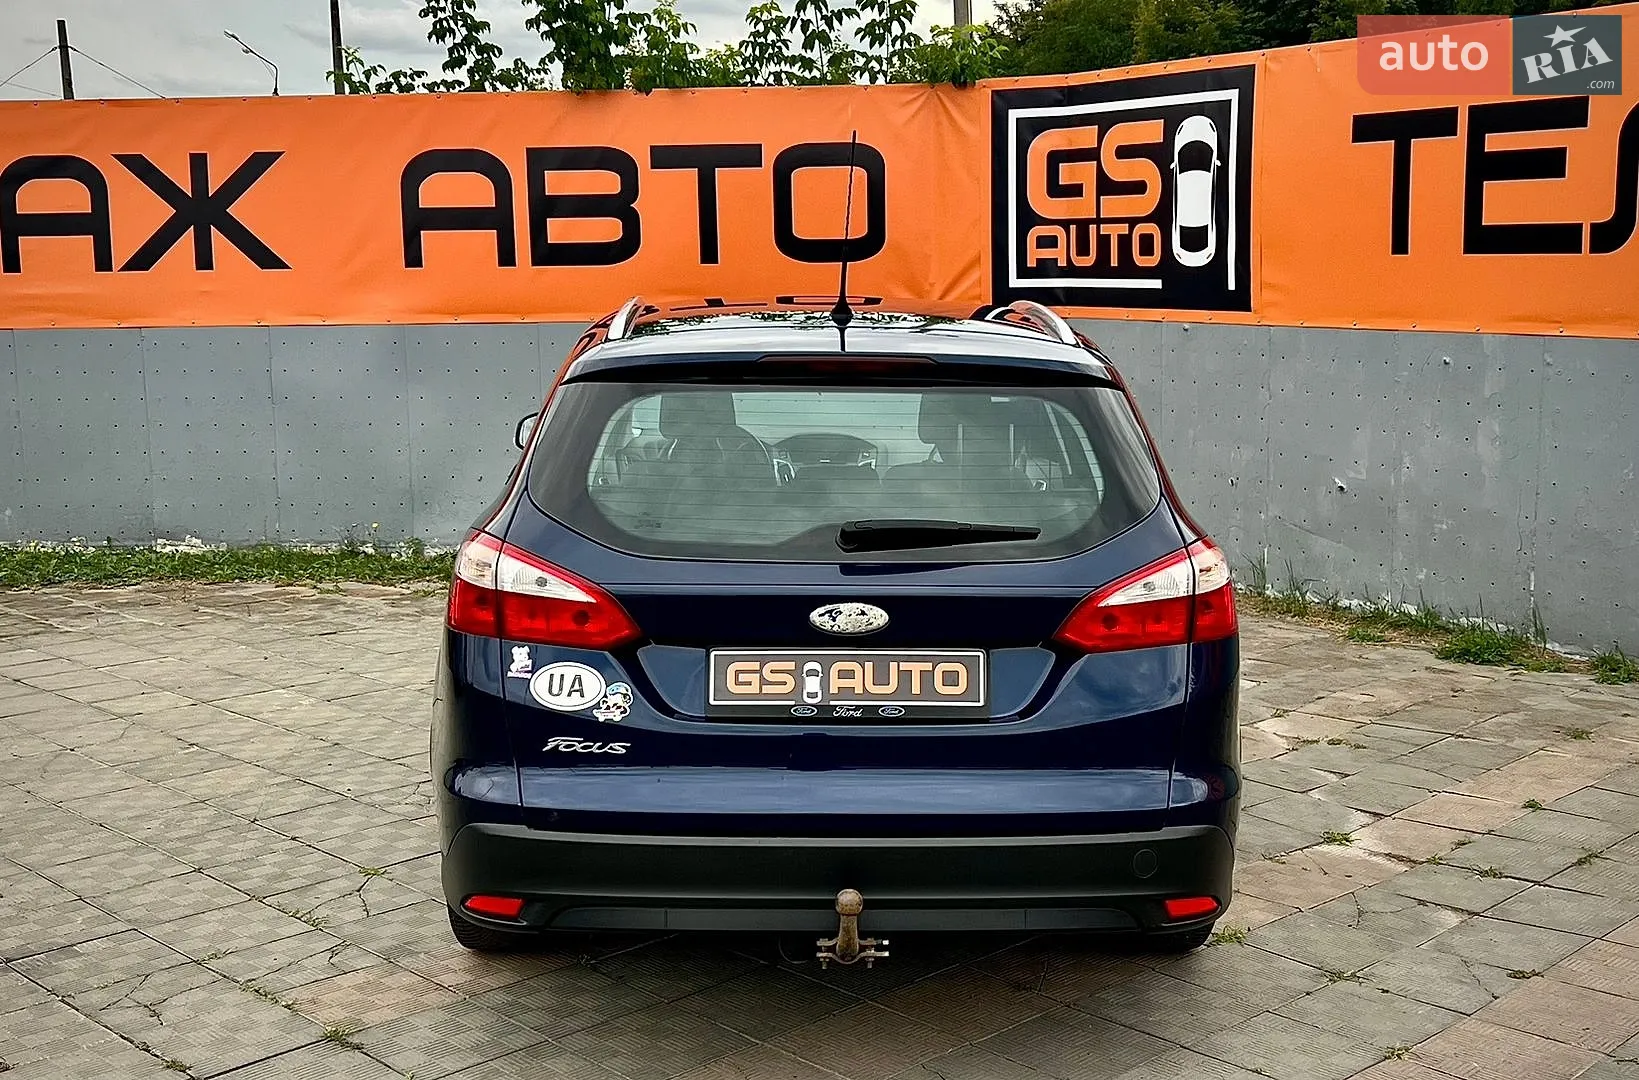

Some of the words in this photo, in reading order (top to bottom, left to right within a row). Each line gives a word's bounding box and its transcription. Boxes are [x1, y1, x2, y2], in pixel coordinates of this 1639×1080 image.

[1027, 119, 1165, 220] GS
[400, 142, 887, 269] АВТО
[1027, 223, 1163, 268] AUTO
[547, 673, 585, 698] UA
[726, 661, 797, 695] GS
[829, 661, 969, 696] AUTO
[832, 705, 864, 717] Ford
